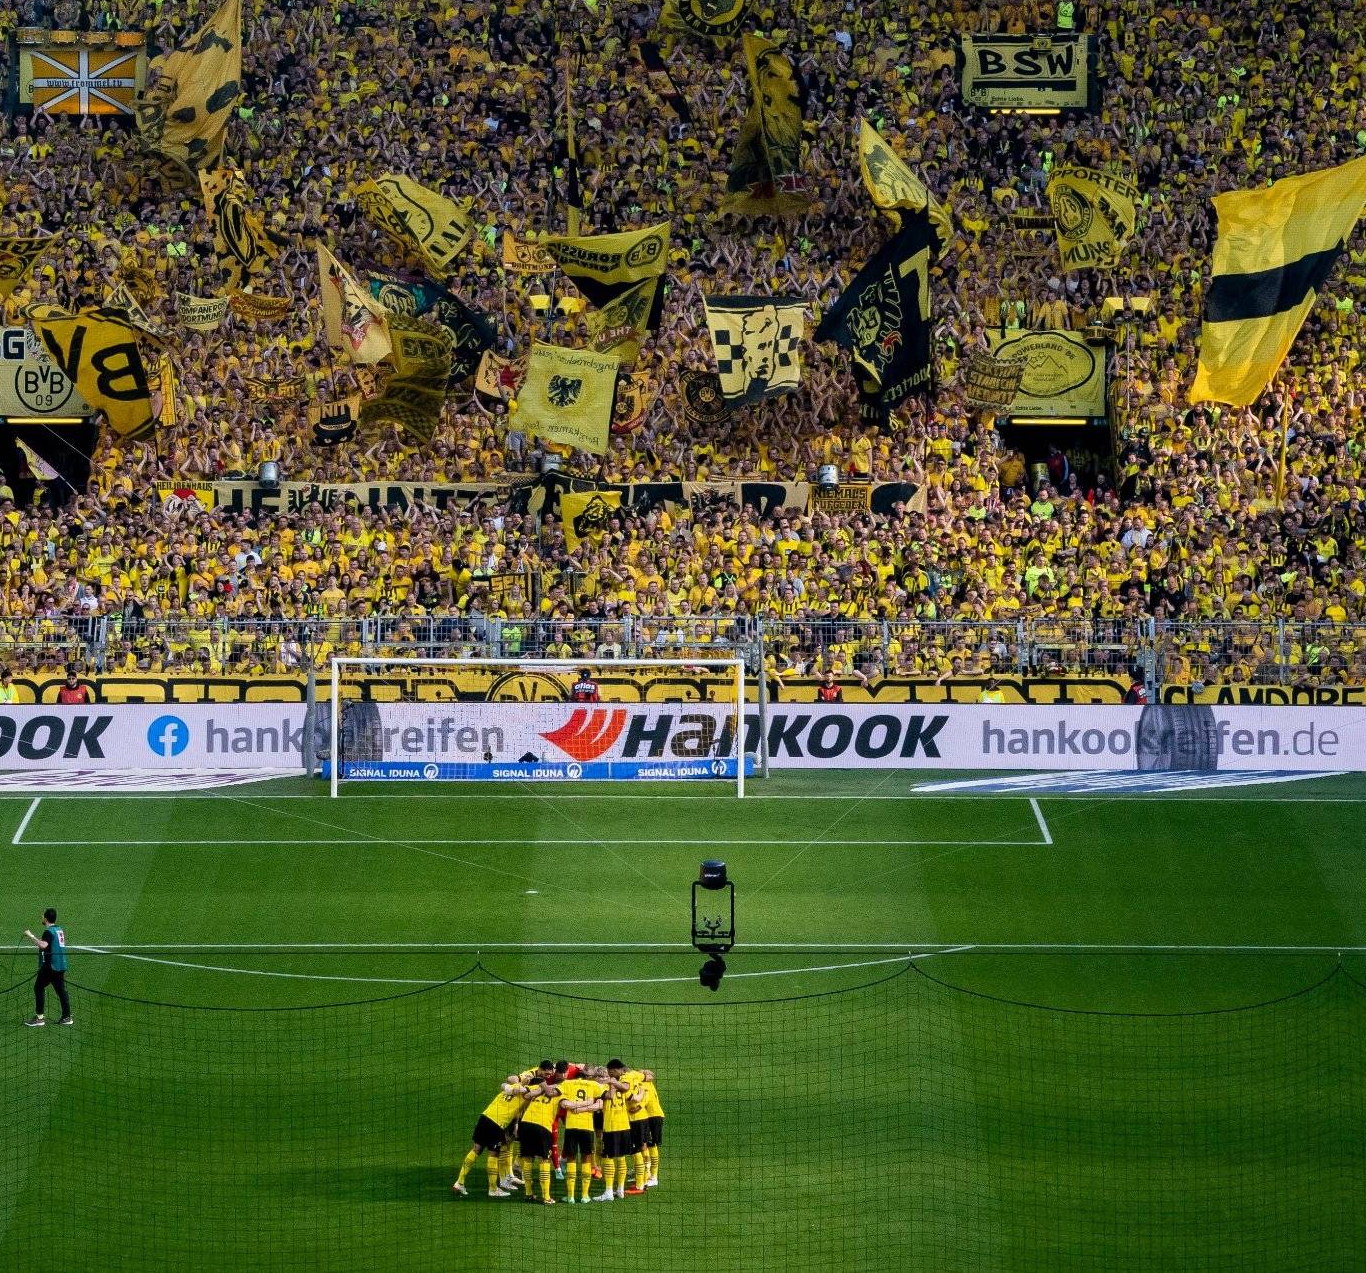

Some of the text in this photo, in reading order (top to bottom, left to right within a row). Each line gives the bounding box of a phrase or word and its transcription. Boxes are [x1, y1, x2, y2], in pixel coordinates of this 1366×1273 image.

[978, 44, 1074, 77] BSW
[24, 365, 65, 394] BVB
[35, 395, 54, 407] 09
[573, 682, 595, 691] atlas
[349, 768, 420, 778] SIGNAL IDUNA
[492, 768, 564, 778] SIGNAL IDUNA
[637, 766, 708, 777] SIGNAL IDUNA
[576, 1088, 586, 1102] 9
